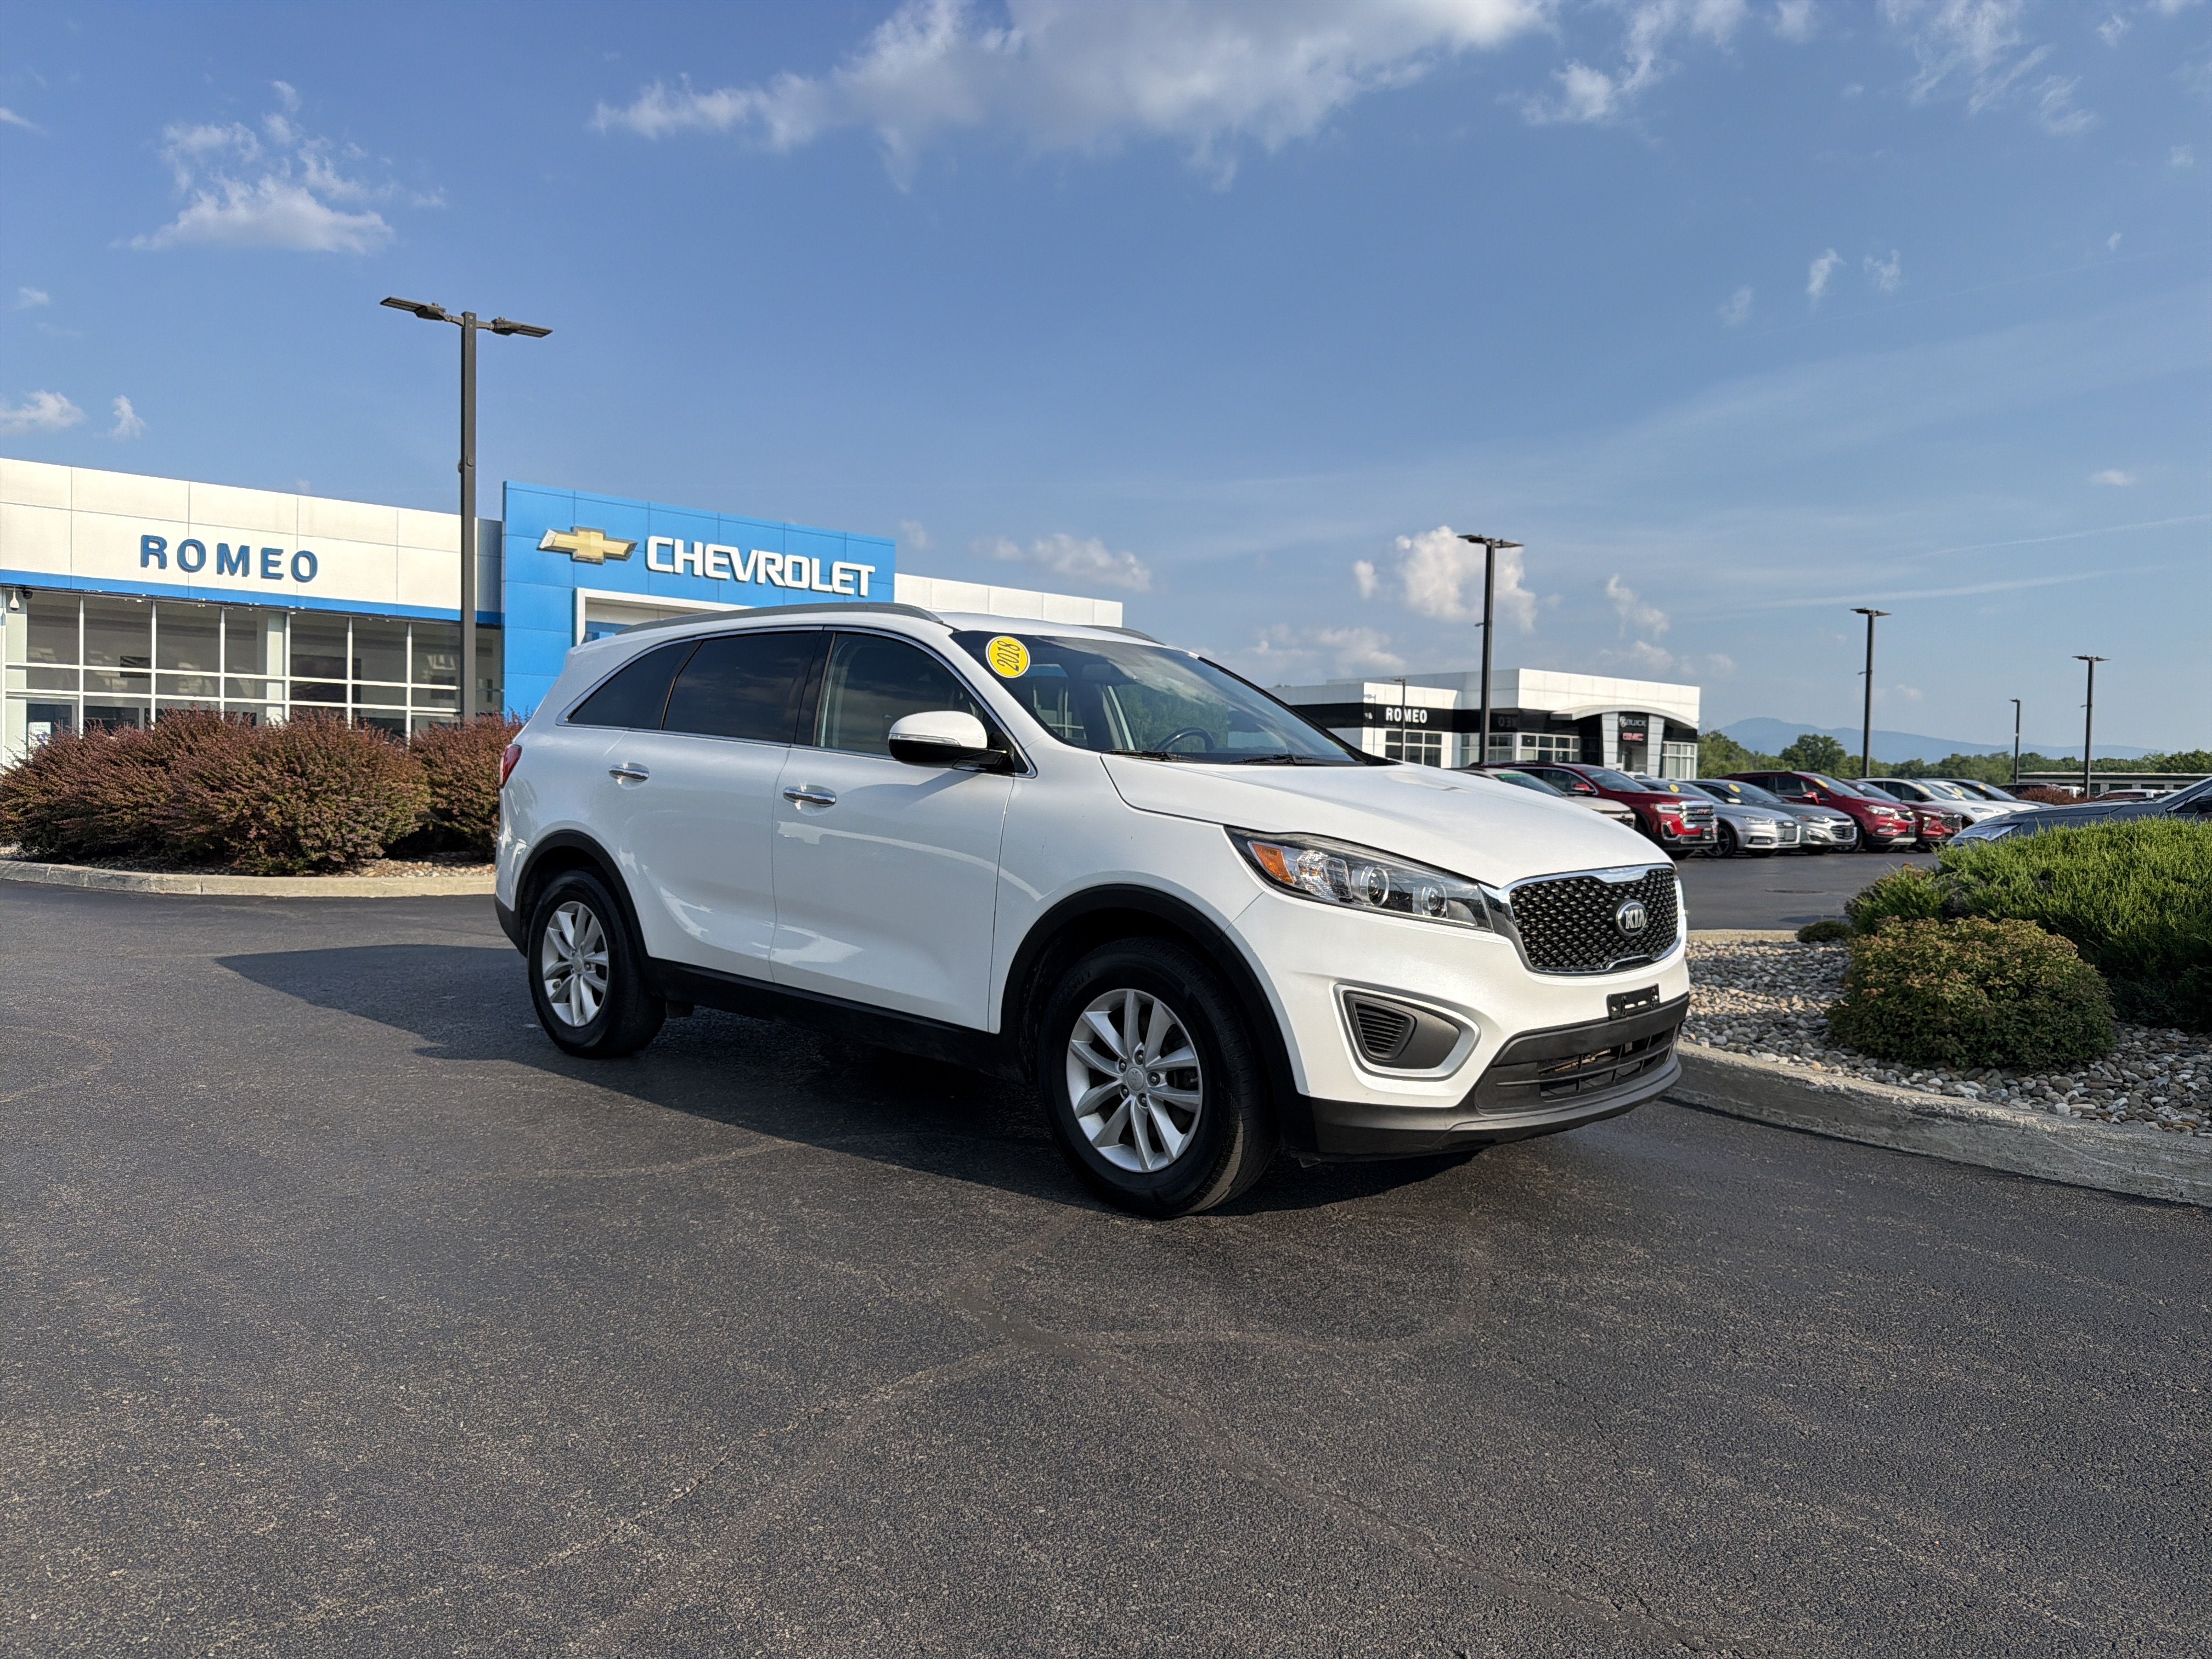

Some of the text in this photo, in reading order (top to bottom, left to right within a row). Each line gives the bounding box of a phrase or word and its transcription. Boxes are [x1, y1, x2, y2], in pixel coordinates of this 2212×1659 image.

[140, 534, 318, 583] ROMEO
[647, 535, 876, 597] CHEVROLET
[996, 640, 1020, 672] 2018
[1385, 707, 1427, 724] ROMEO
[1624, 909, 1645, 929] KIA
